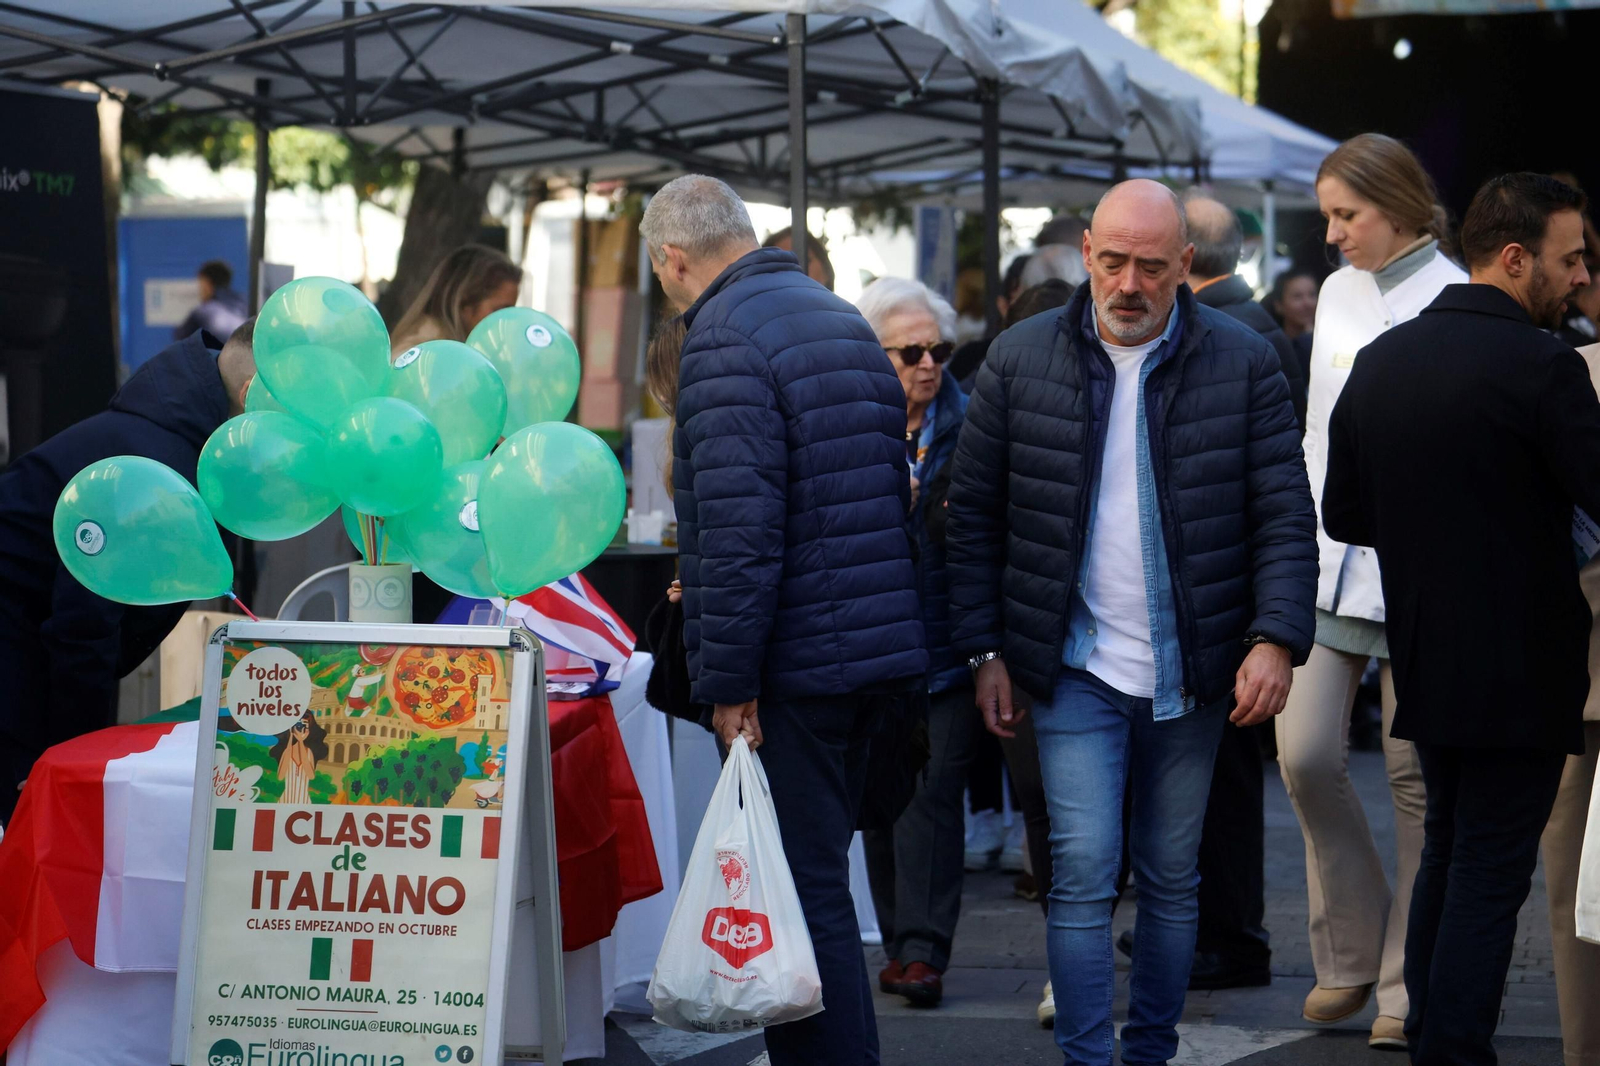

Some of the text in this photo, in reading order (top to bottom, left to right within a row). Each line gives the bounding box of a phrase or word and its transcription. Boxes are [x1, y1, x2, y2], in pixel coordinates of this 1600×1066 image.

[32, 170, 76, 196] TM7
[245, 663, 298, 681] todos
[259, 681, 282, 698] los
[237, 698, 301, 717] niveles
[212, 765, 239, 797] taly
[284, 810, 431, 849] CLASES
[331, 844, 367, 871] de
[251, 870, 466, 916] ITALIANO
[733, 873, 751, 901] RECICLADO
[246, 918, 457, 937] CLASES EMPEZANDO EN OCTUBRE
[218, 983, 484, 1008] C/ ANTONIO MAURA, 25 14004
[208, 1015, 477, 1036] 957475035 EUROLINGUA@EUROLINGUA.ES
[269, 1038, 316, 1051] Idiomas
